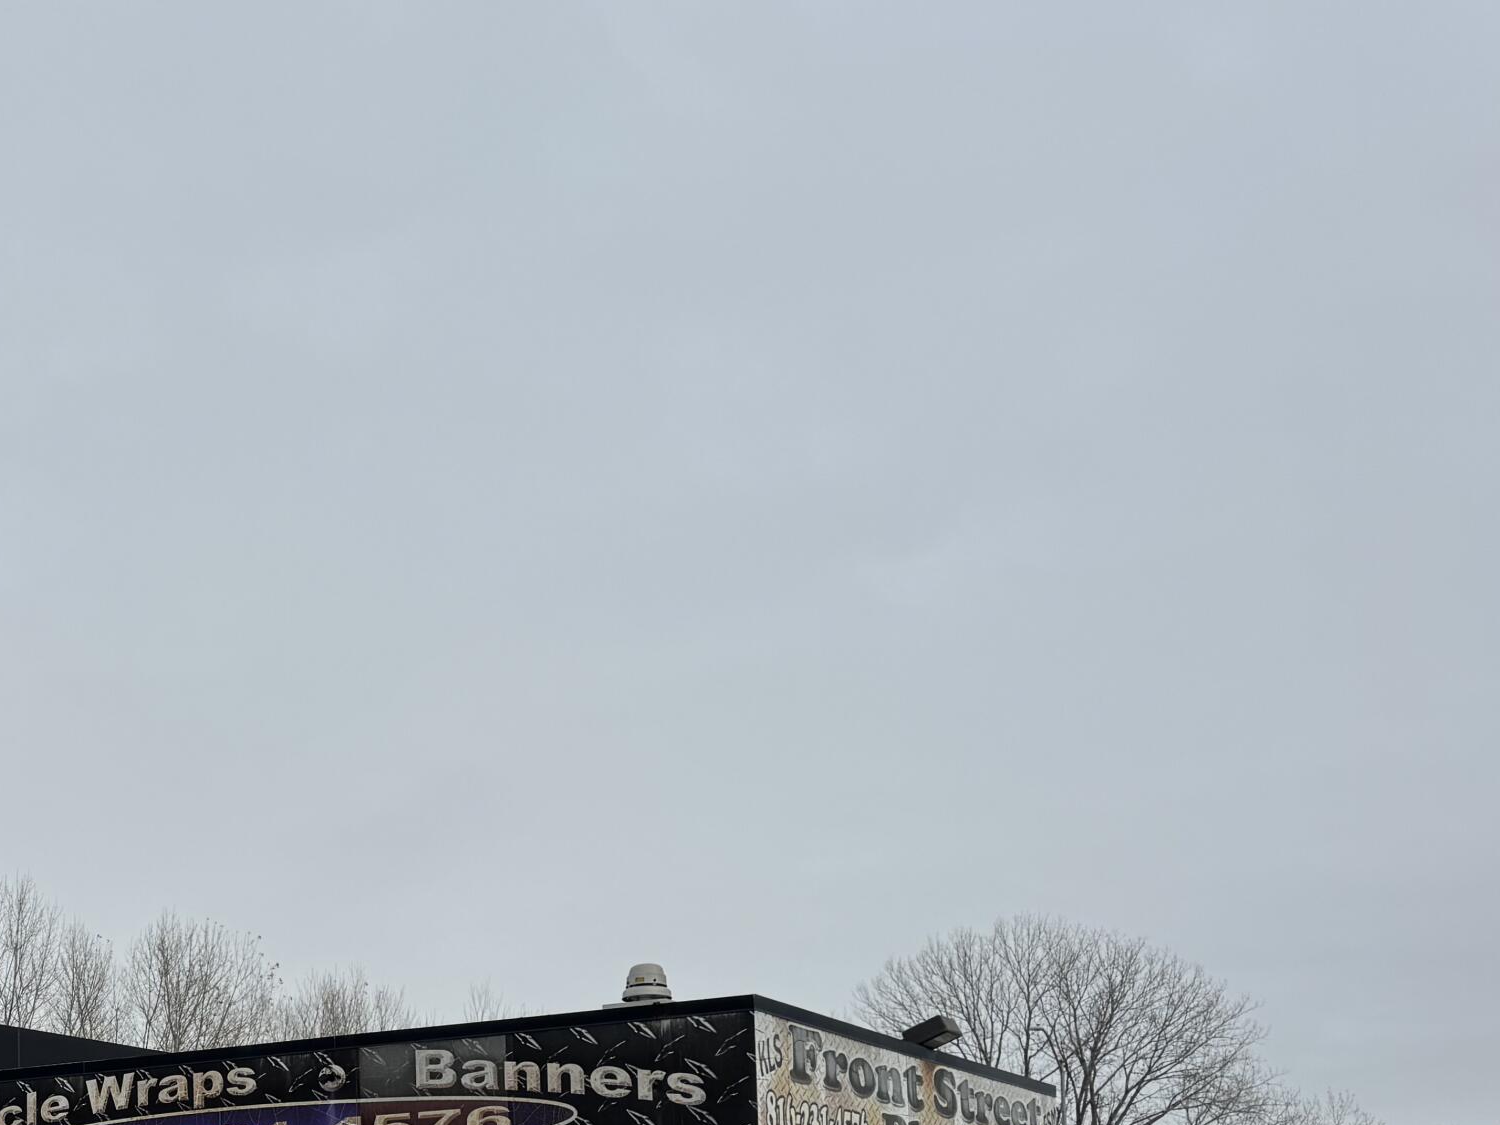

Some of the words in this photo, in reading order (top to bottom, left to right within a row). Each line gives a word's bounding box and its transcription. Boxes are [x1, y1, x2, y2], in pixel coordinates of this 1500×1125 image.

[86, 1065, 257, 1115] Wraps
[414, 1049, 707, 1103] Banners
[757, 1034, 783, 1077] KLS
[788, 1024, 924, 1112] Front
